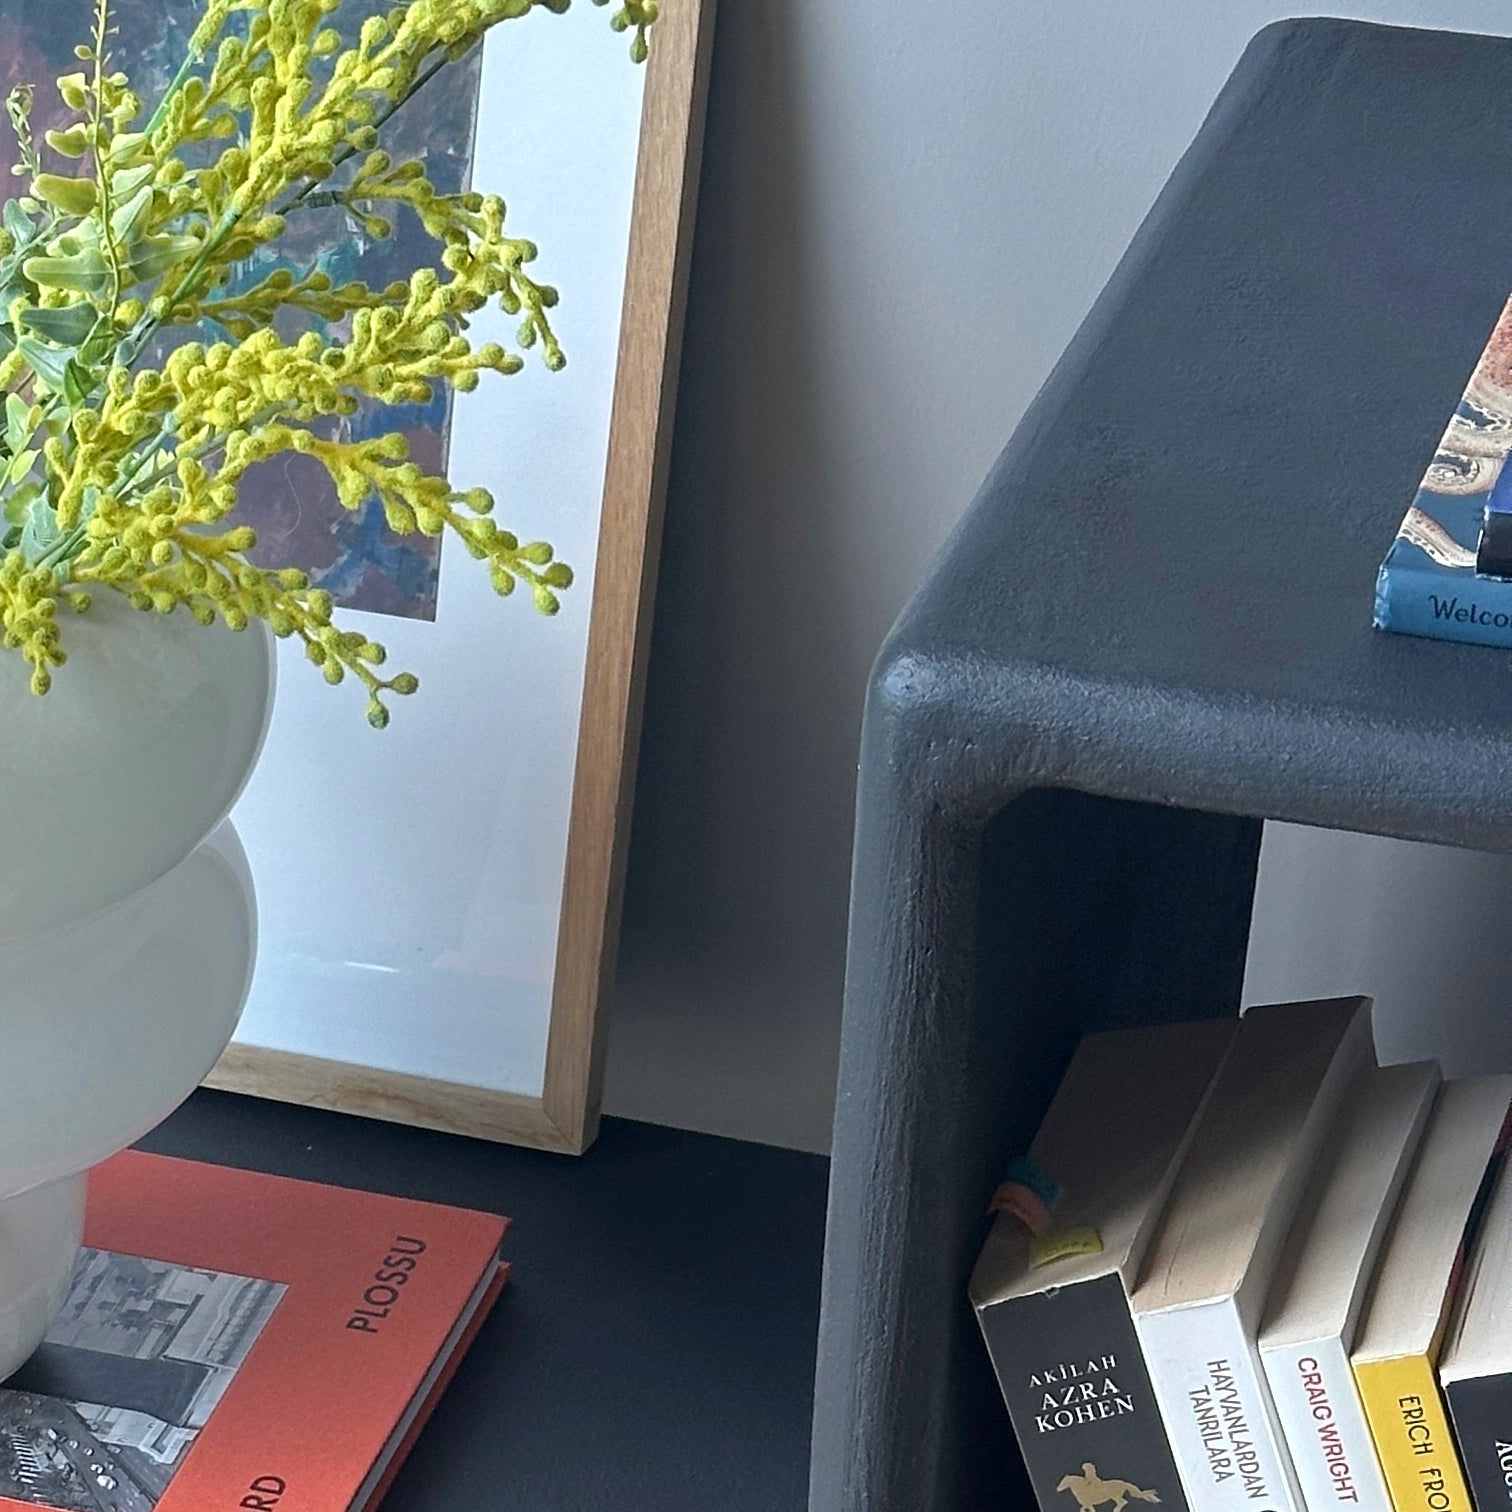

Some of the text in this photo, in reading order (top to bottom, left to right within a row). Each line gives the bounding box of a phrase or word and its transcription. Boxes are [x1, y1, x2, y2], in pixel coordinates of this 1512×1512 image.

[1429, 594, 1512, 628] Welco
[346, 1236, 426, 1333] PLOSSU
[1028, 1354, 1118, 1389] AKİLAH
[1041, 1377, 1122, 1411] AZRA
[1034, 1394, 1136, 1433] KOHEN
[1188, 1384, 1236, 1483] TANRILARA
[1207, 1359, 1269, 1499] HAYVANLARDAN
[1298, 1357, 1359, 1503] CRAIG WRIGHT
[1398, 1395, 1434, 1456] ERICH
